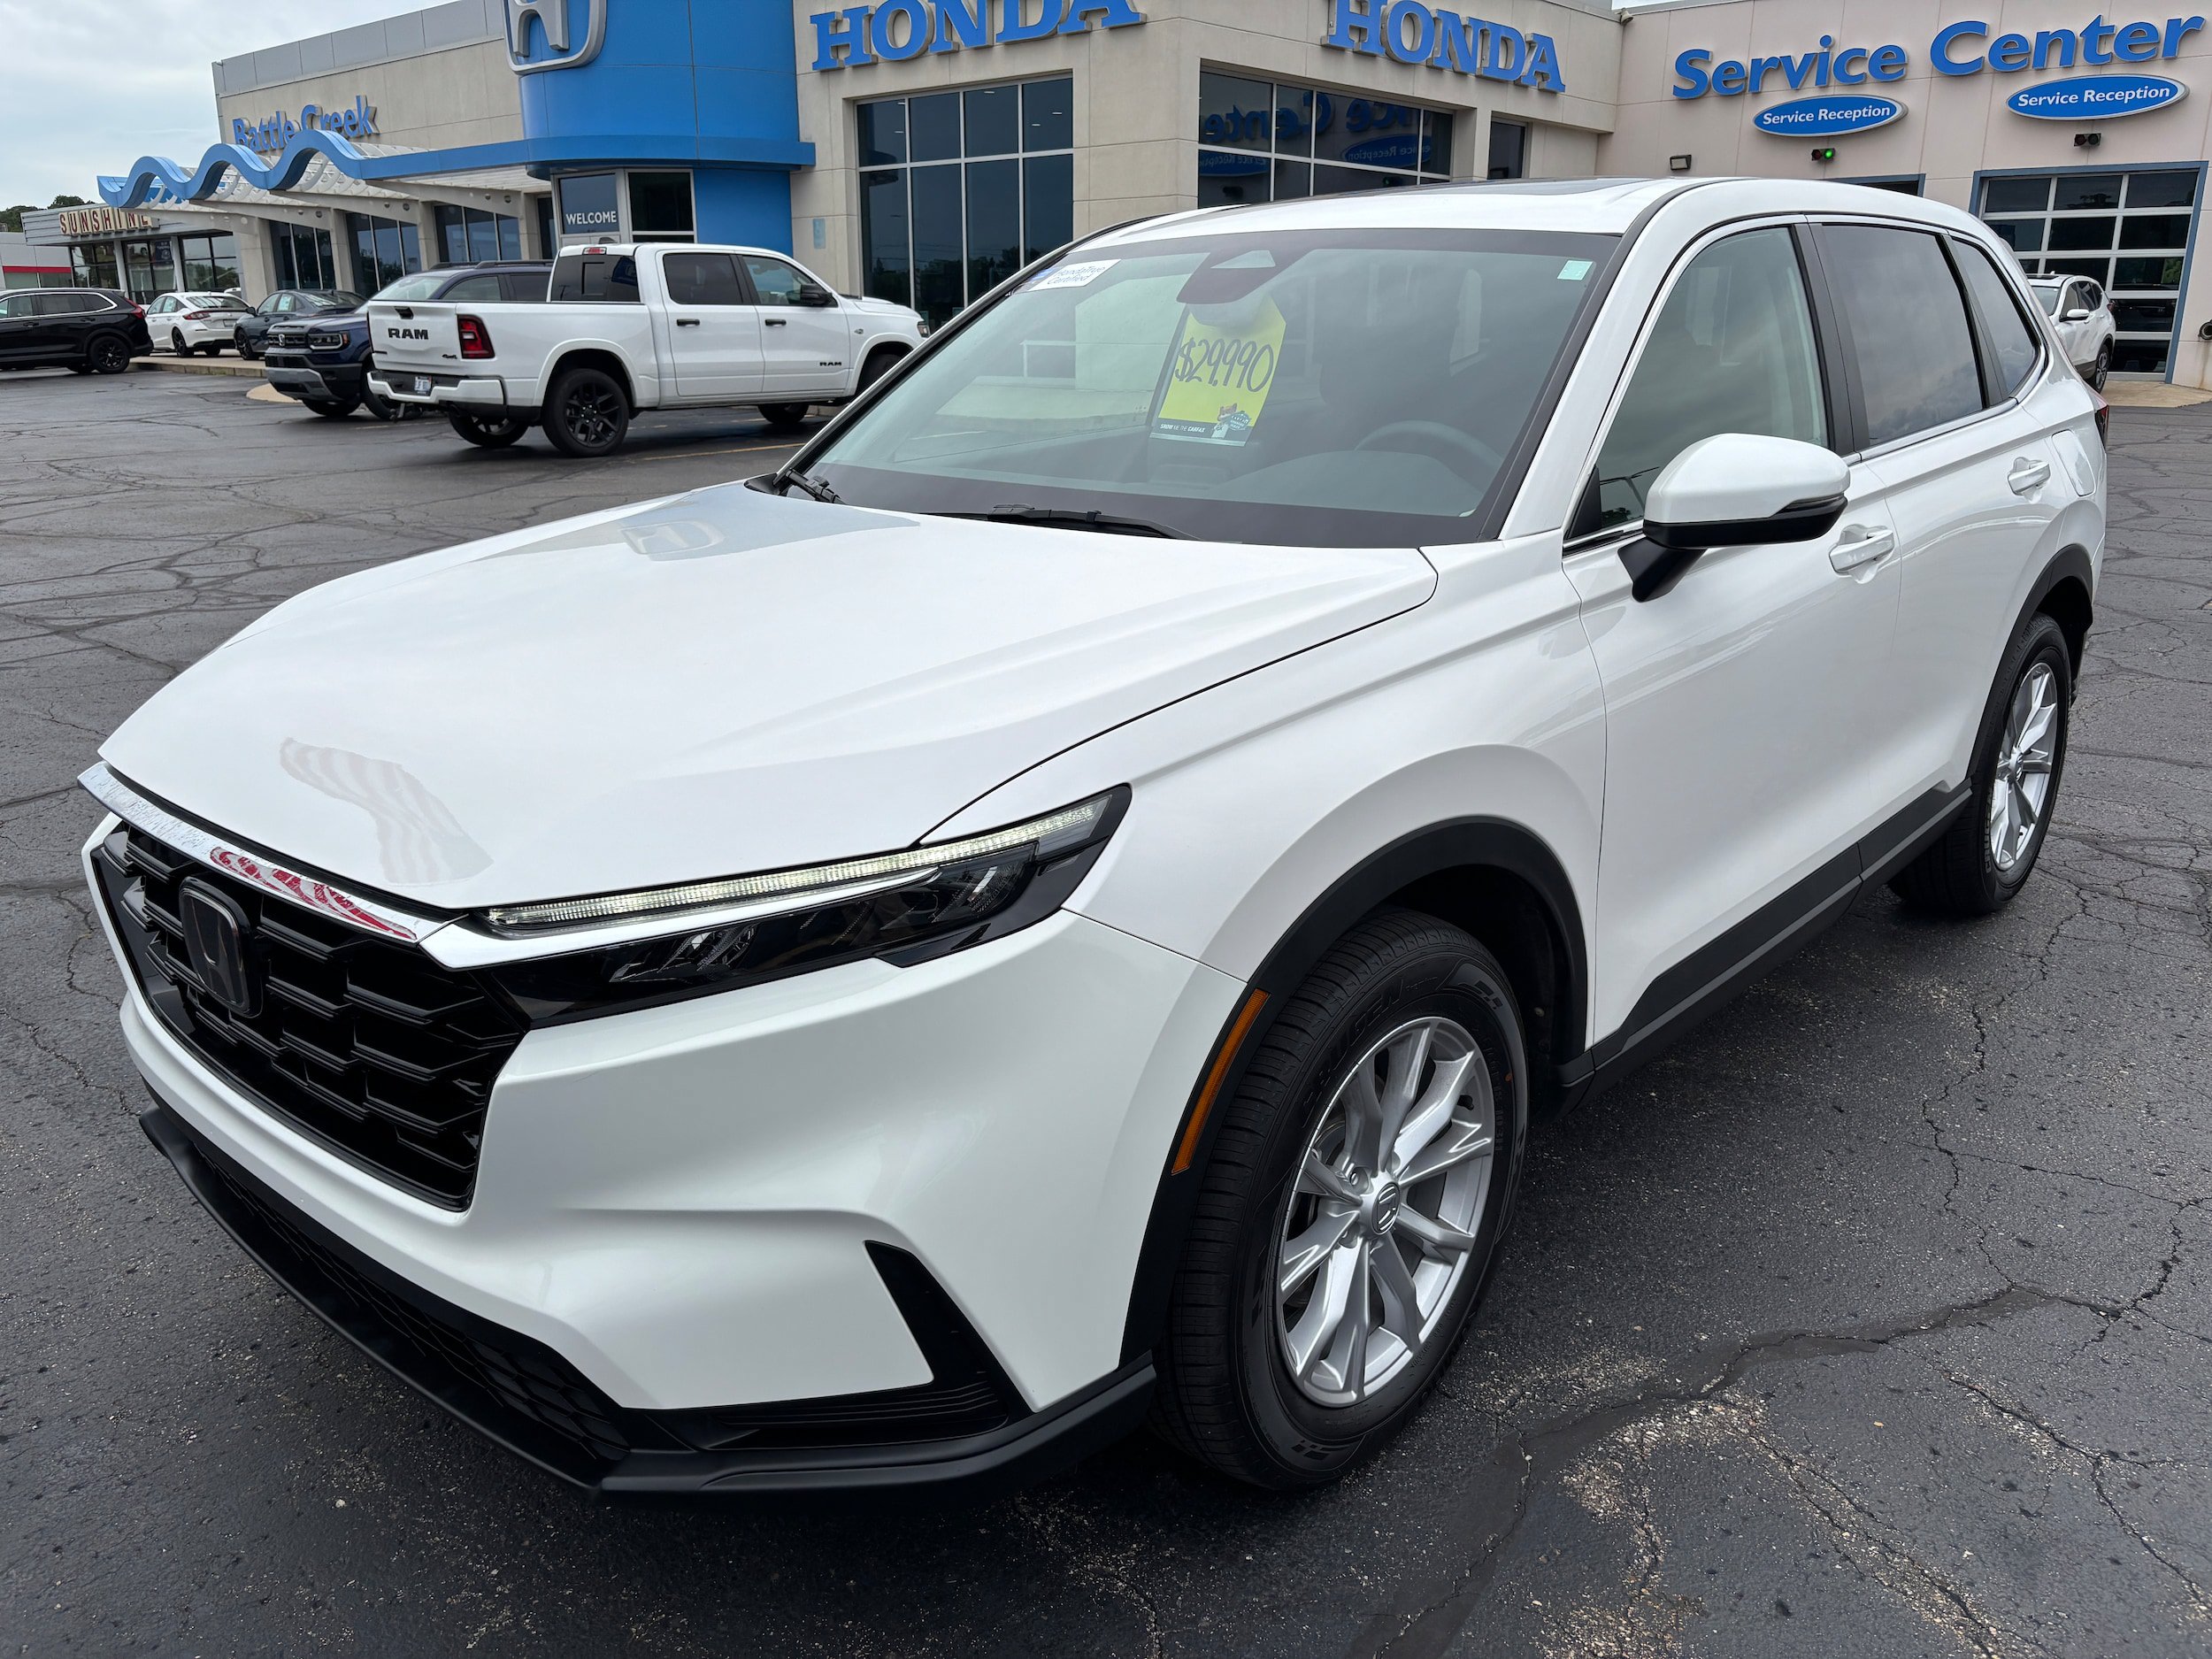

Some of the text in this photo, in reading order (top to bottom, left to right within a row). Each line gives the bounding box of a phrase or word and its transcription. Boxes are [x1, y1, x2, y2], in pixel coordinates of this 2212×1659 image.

[1328, 0, 1566, 93] HONDA
[1672, 14, 2206, 99] Service Center
[1763, 105, 1890, 125] Service Reception
[2017, 85, 2170, 107] Service Reception
[232, 95, 376, 153] Battle Creek
[565, 211, 617, 226] WELCOME
[388, 327, 429, 340] RAM
[1175, 337, 1274, 393] $29,990
